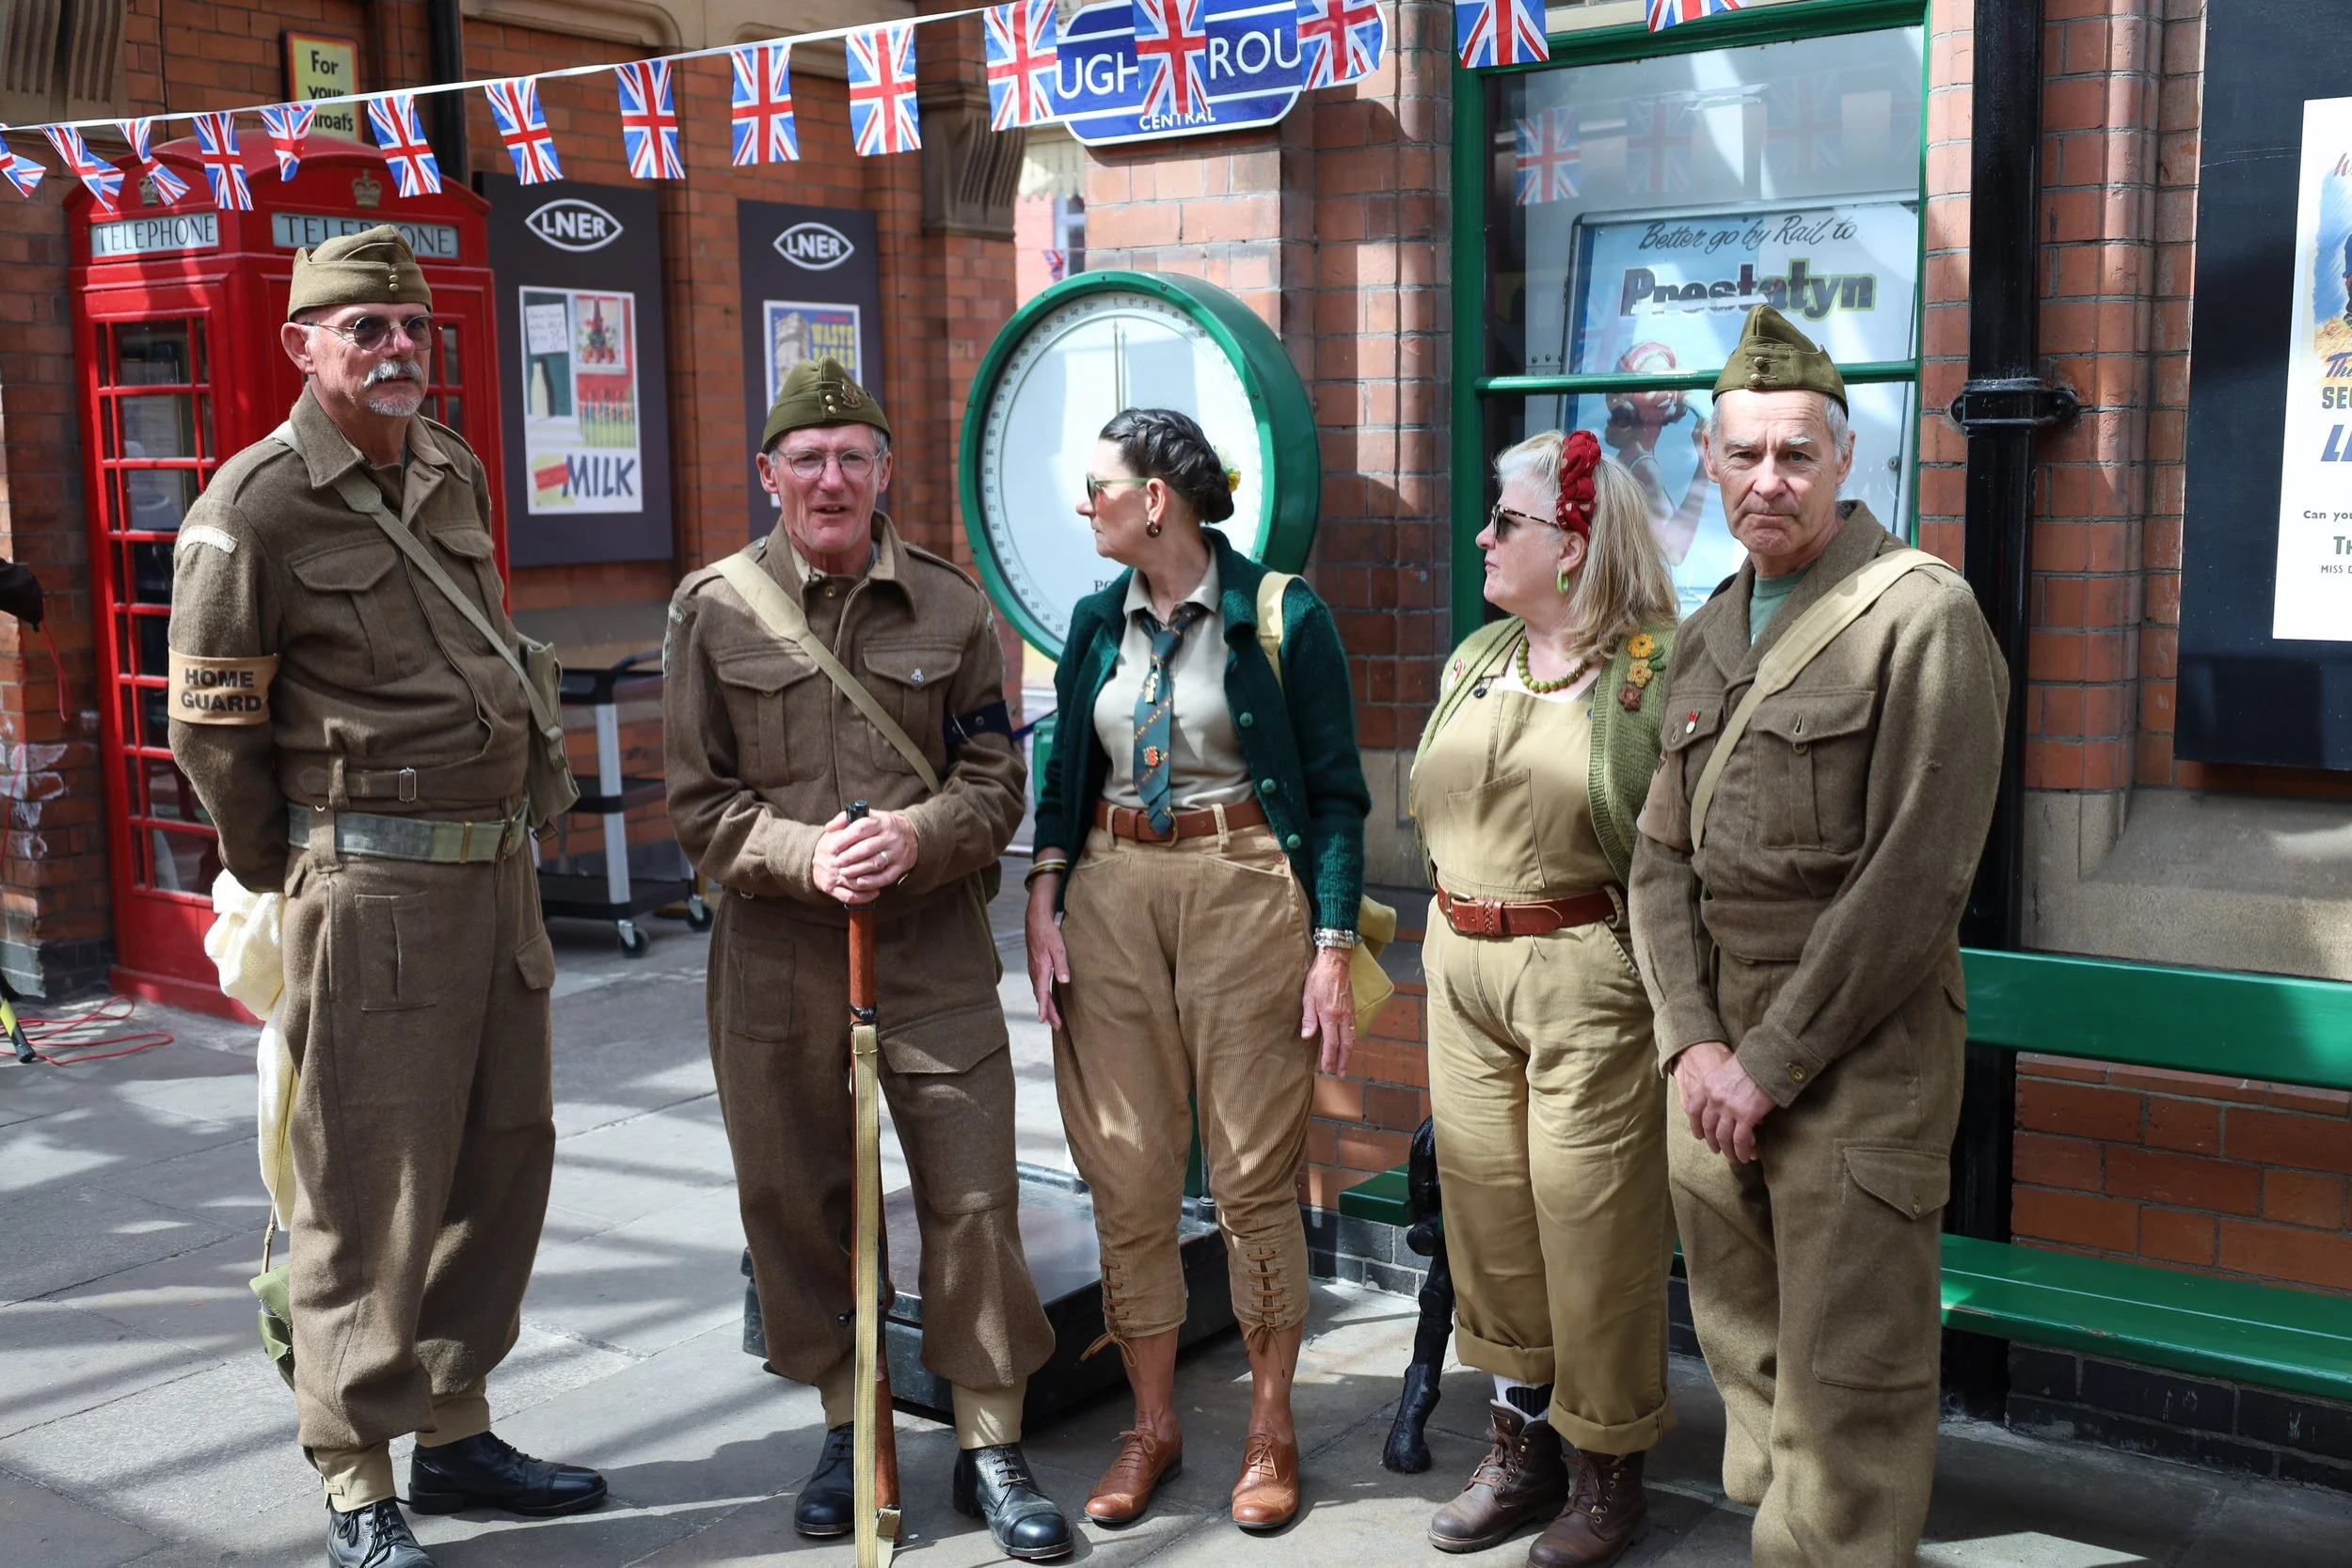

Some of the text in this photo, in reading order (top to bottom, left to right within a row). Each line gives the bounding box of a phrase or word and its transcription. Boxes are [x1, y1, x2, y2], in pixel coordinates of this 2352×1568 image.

[310, 50, 339, 75] For
[96, 214, 215, 253] TELEPHONE
[541, 210, 608, 240] LNER
[1639, 214, 1858, 255] Better go by Rail to
[787, 233, 841, 260] LNER
[562, 453, 635, 498] MILK
[2303, 510, 2327, 519] Can
[2320, 564, 2344, 574] MISS
[184, 667, 255, 689] HOME
[180, 691, 262, 712] GUARD
